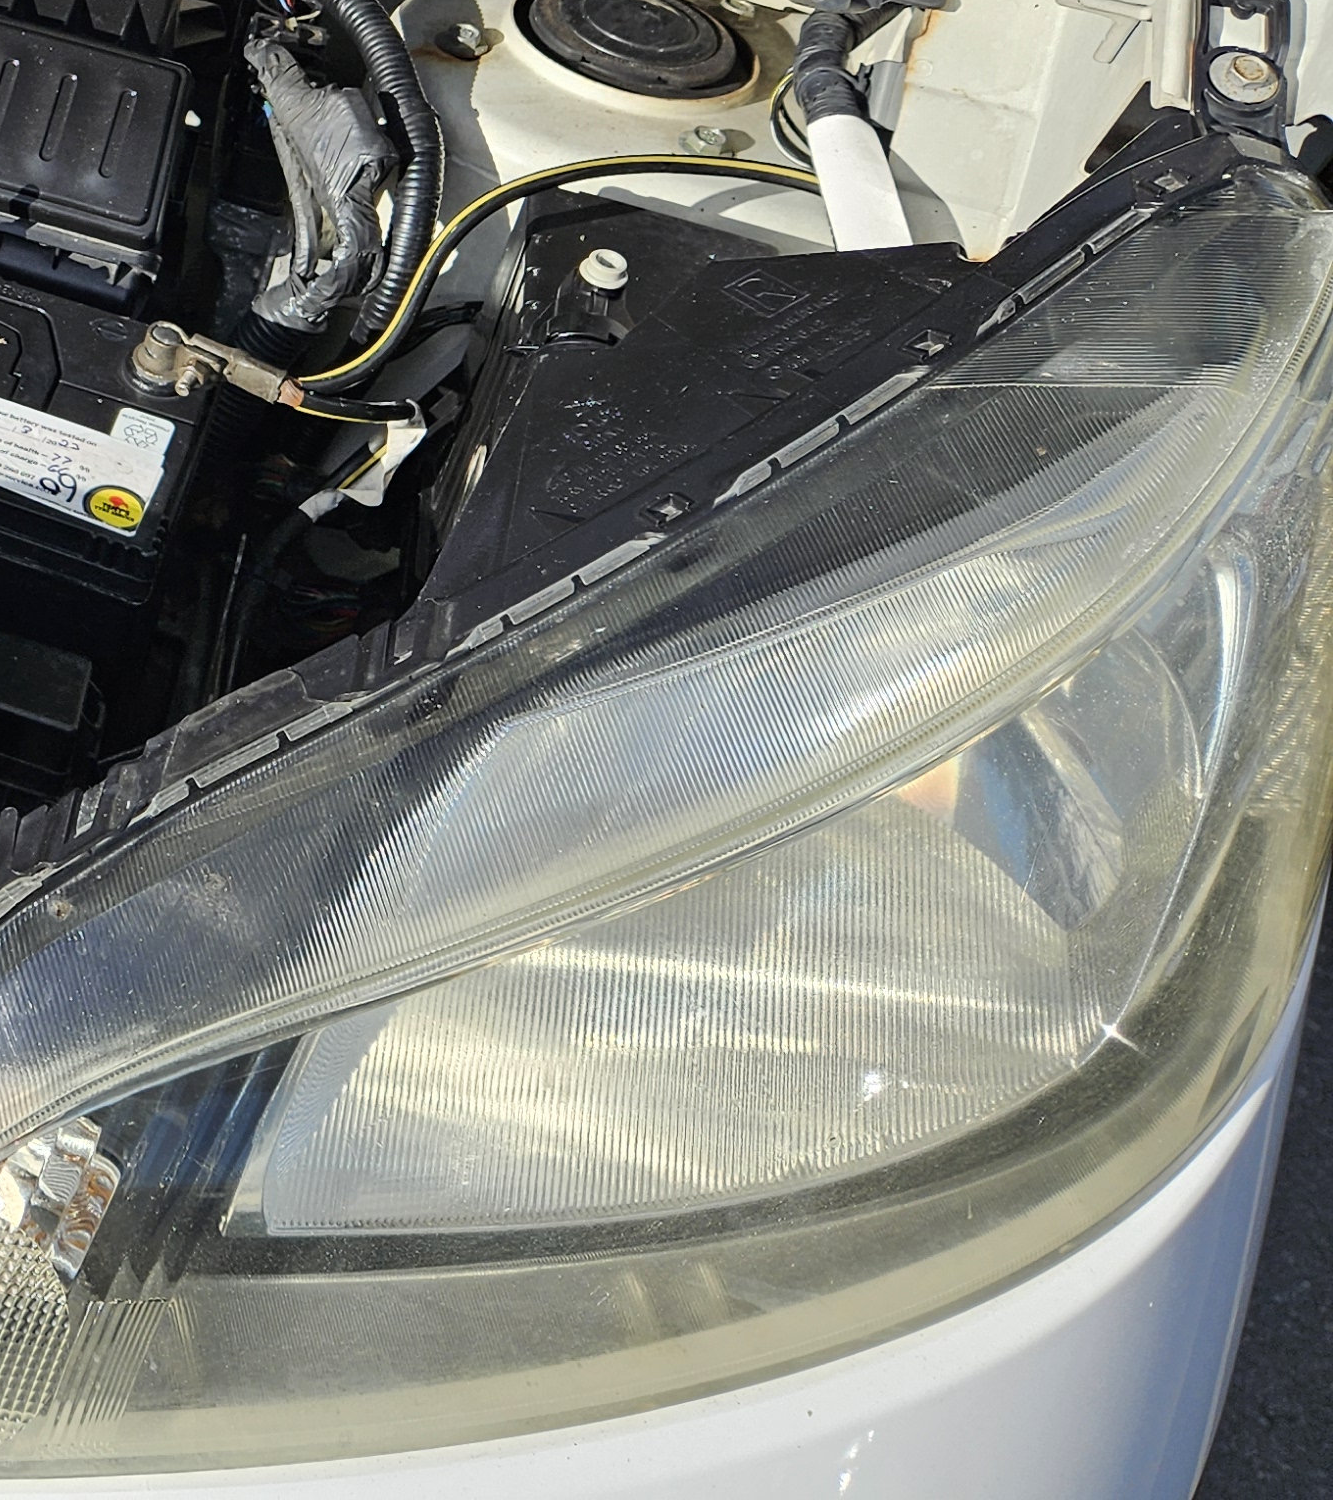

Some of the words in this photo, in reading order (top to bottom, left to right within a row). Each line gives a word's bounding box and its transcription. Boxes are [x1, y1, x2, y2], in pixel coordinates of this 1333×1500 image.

[9, 414, 39, 429] battery
[41, 425, 57, 433] was
[59, 429, 86, 443] tested
[14, 442, 40, 456] health
[10, 451, 39, 468] charge
